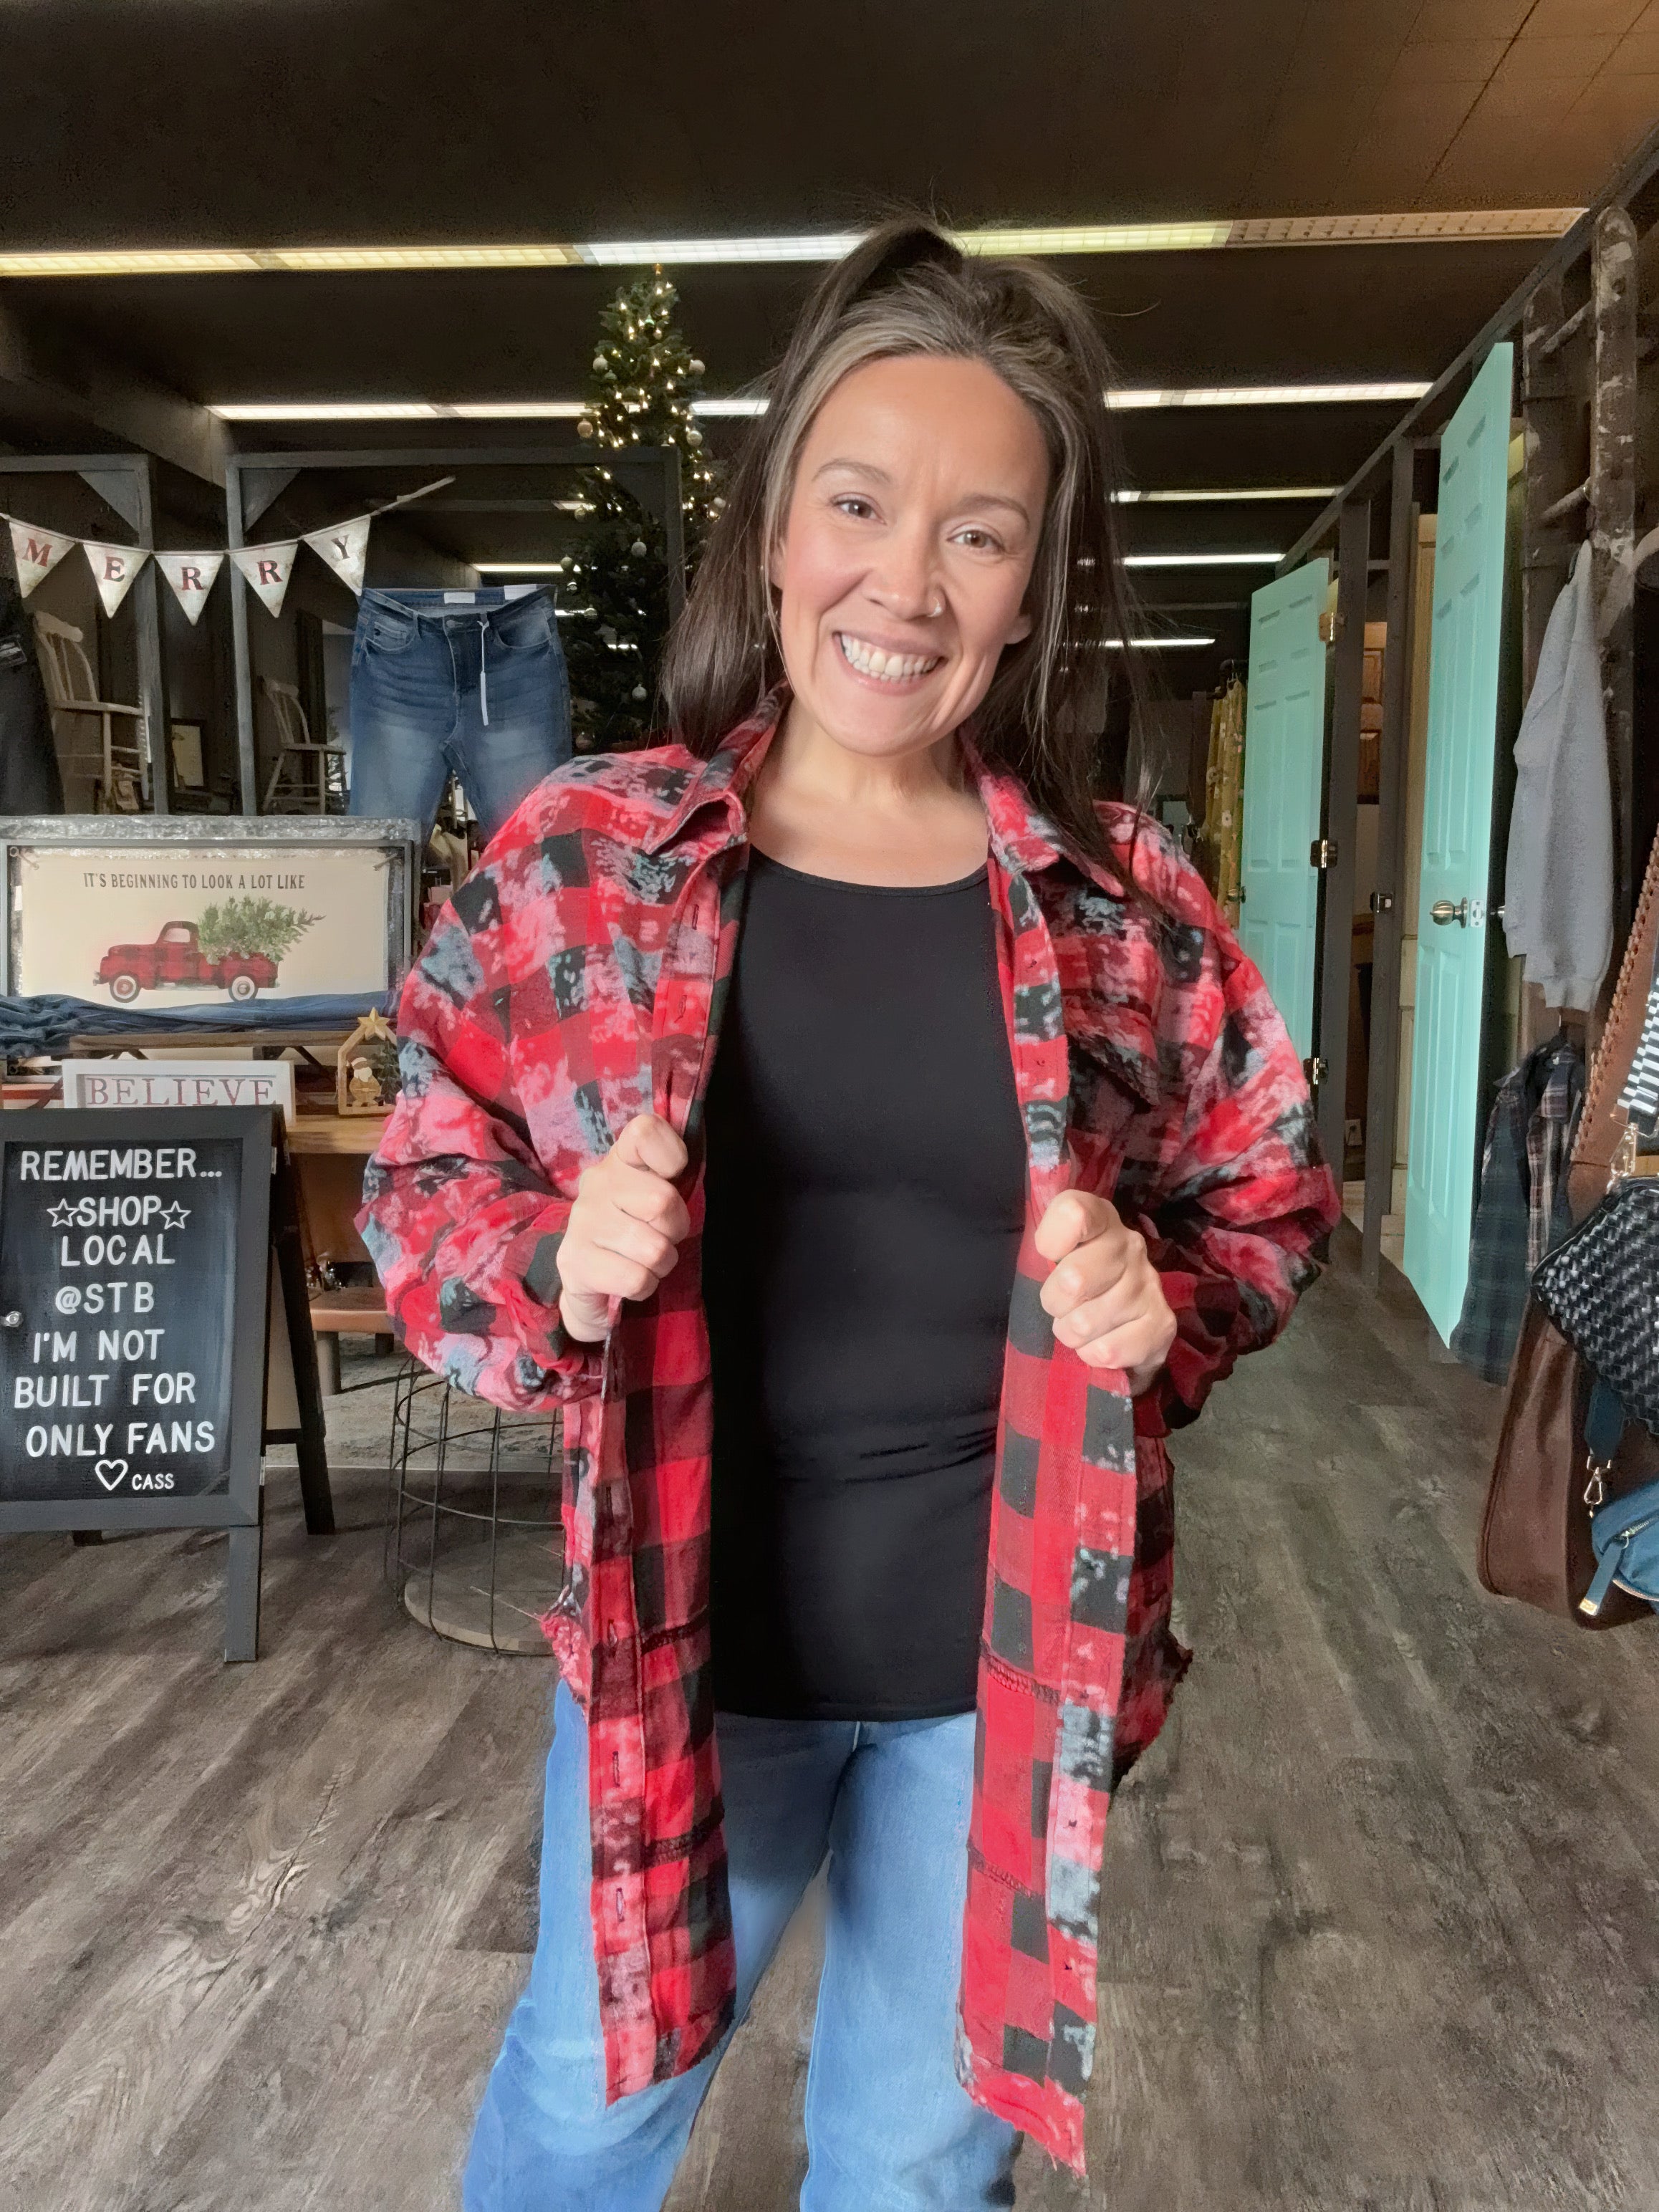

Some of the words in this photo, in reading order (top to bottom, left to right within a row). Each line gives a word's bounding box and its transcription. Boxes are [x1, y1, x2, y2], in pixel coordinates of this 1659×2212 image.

[22, 536, 352, 592] MERRY
[83, 872, 107, 888] IT'S
[111, 873, 178, 889] BEGINNING
[182, 874, 197, 889] TO
[201, 875, 234, 889] LOOK
[238, 875, 246, 889] A
[251, 875, 273, 889] LOT
[278, 875, 306, 889] LIKE
[86, 1077, 276, 1106] BELIEVE
[20, 1148, 222, 1180] REMEMBER...
[77, 1196, 162, 1227] SHOP
[61, 1234, 175, 1266] LOCAL
[55, 1281, 155, 1314] @STB
[33, 1331, 77, 1363] I'M
[98, 1329, 165, 1360] NOT
[14, 1374, 110, 1408] BUILT
[133, 1372, 196, 1405] FOR
[26, 1424, 113, 1457] ONLY
[128, 1421, 215, 1454] FANS
[132, 1473, 175, 1491] CASS
